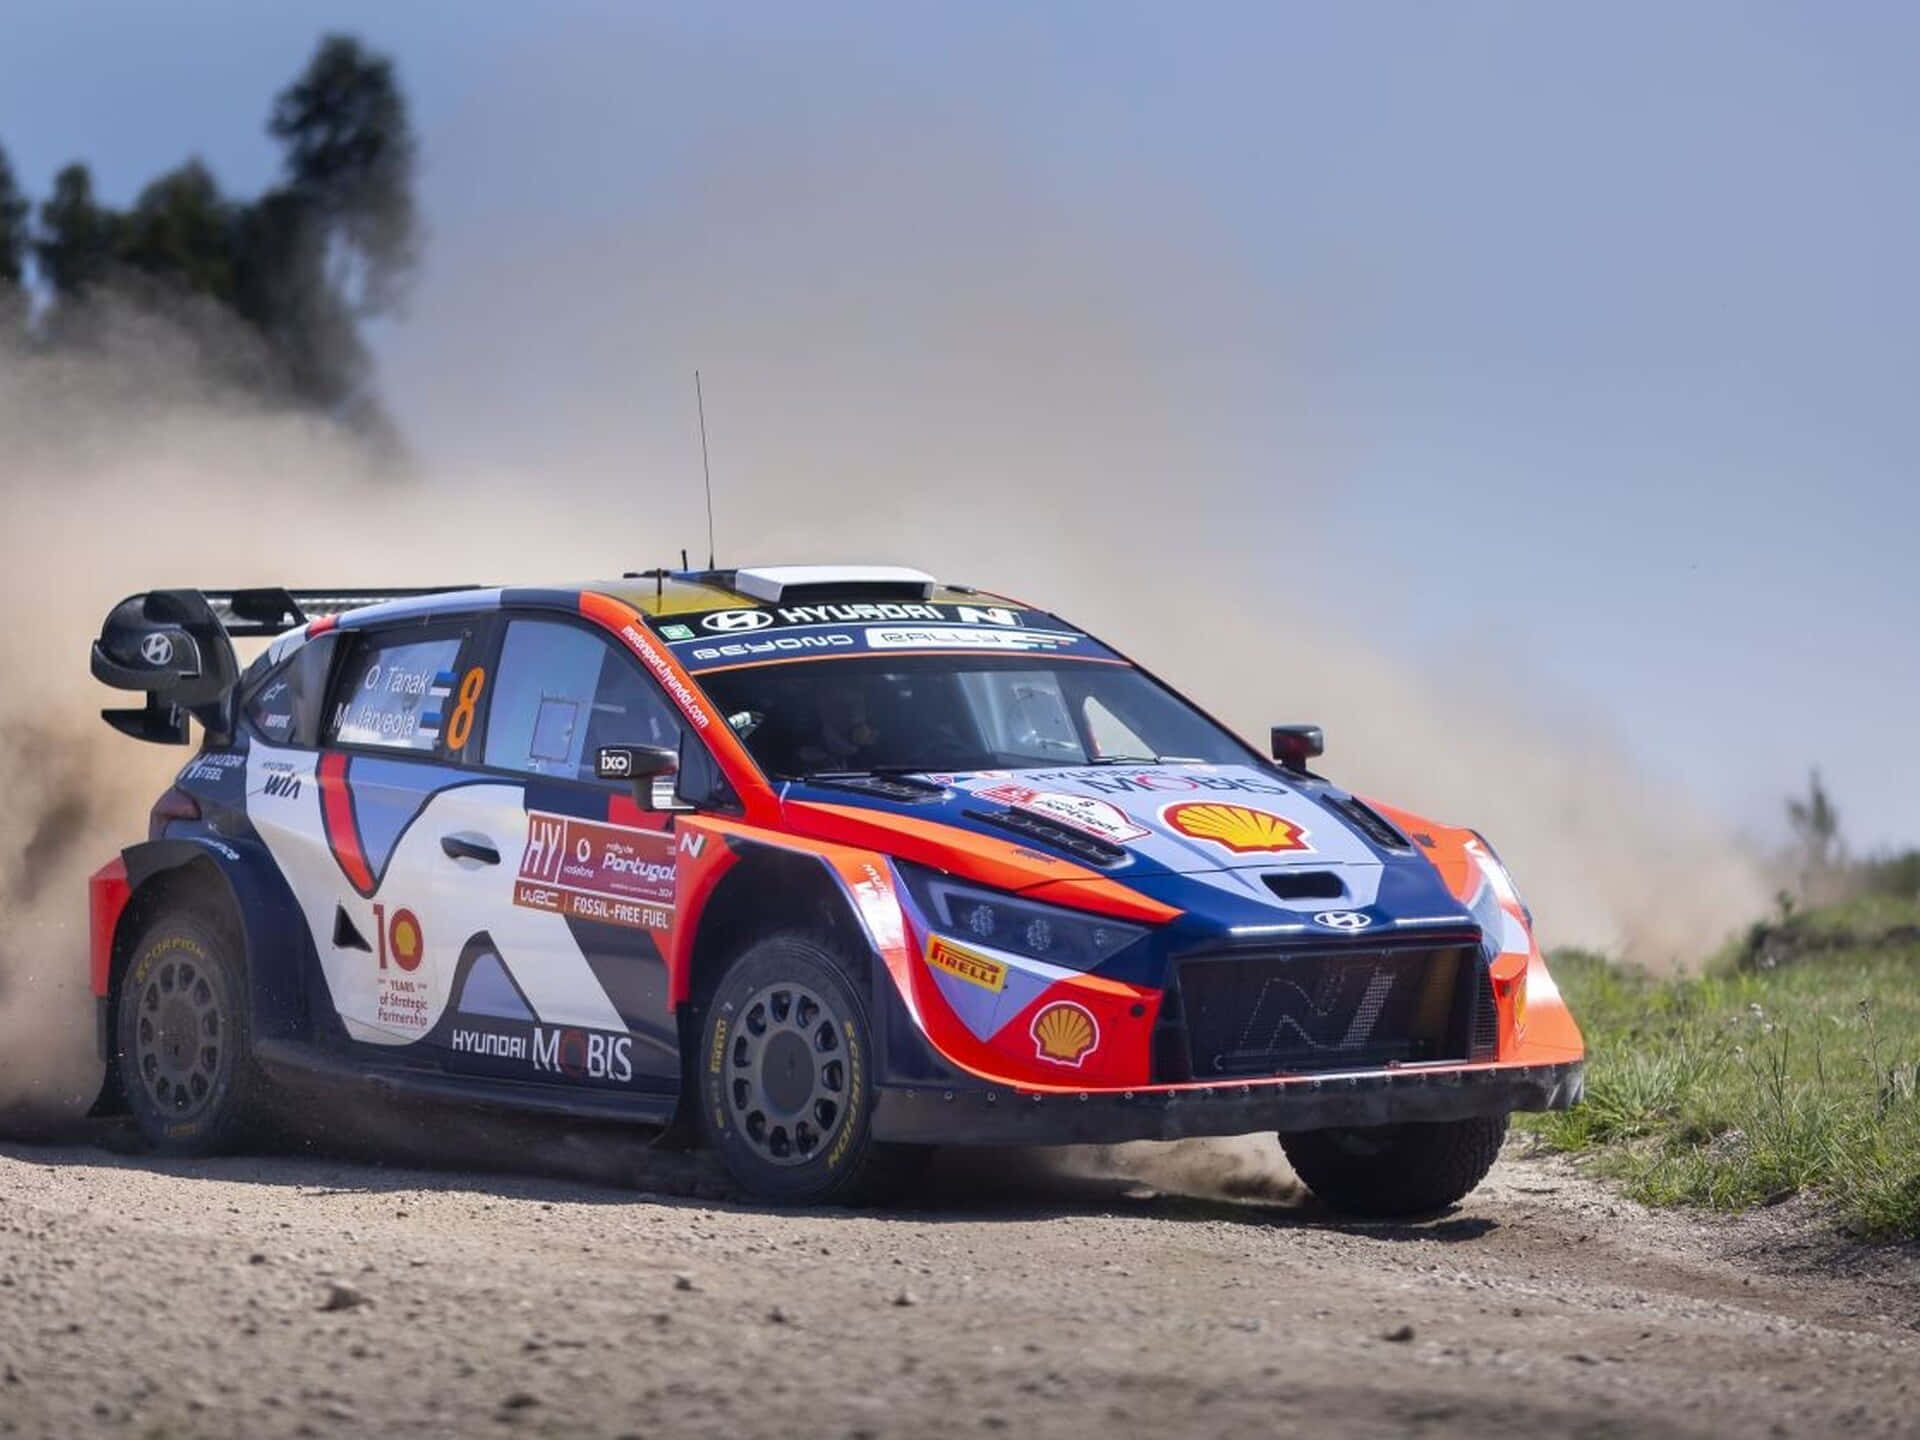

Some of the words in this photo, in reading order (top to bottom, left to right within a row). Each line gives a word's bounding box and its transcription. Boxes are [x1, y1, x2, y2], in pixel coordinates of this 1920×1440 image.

[778, 603, 945, 623] HYUNDAI
[693, 633, 854, 660] BEYOND
[881, 632, 1001, 642] RALLY
[621, 625, 709, 729] motorsport.hyundai.com
[447, 666, 486, 750] 8
[195, 766, 224, 781] STEEL
[601, 750, 628, 770] ixo
[1077, 775, 1289, 796] MOBIS
[522, 820, 561, 876] HY
[680, 832, 706, 859] N
[563, 864, 595, 879] vodafone
[601, 852, 677, 883] Portugal
[520, 887, 560, 907] WRC
[573, 896, 640, 924] FOSSIL-FREE
[641, 908, 670, 929] FUEL
[931, 941, 1001, 985] PIRELLI
[390, 979, 415, 993] YEARS
[452, 1029, 527, 1060] HYUNDAI
[532, 1027, 632, 1082] MOBIS
[710, 1018, 727, 1073] PIRELLI
[828, 1020, 861, 1168] SCORPION
